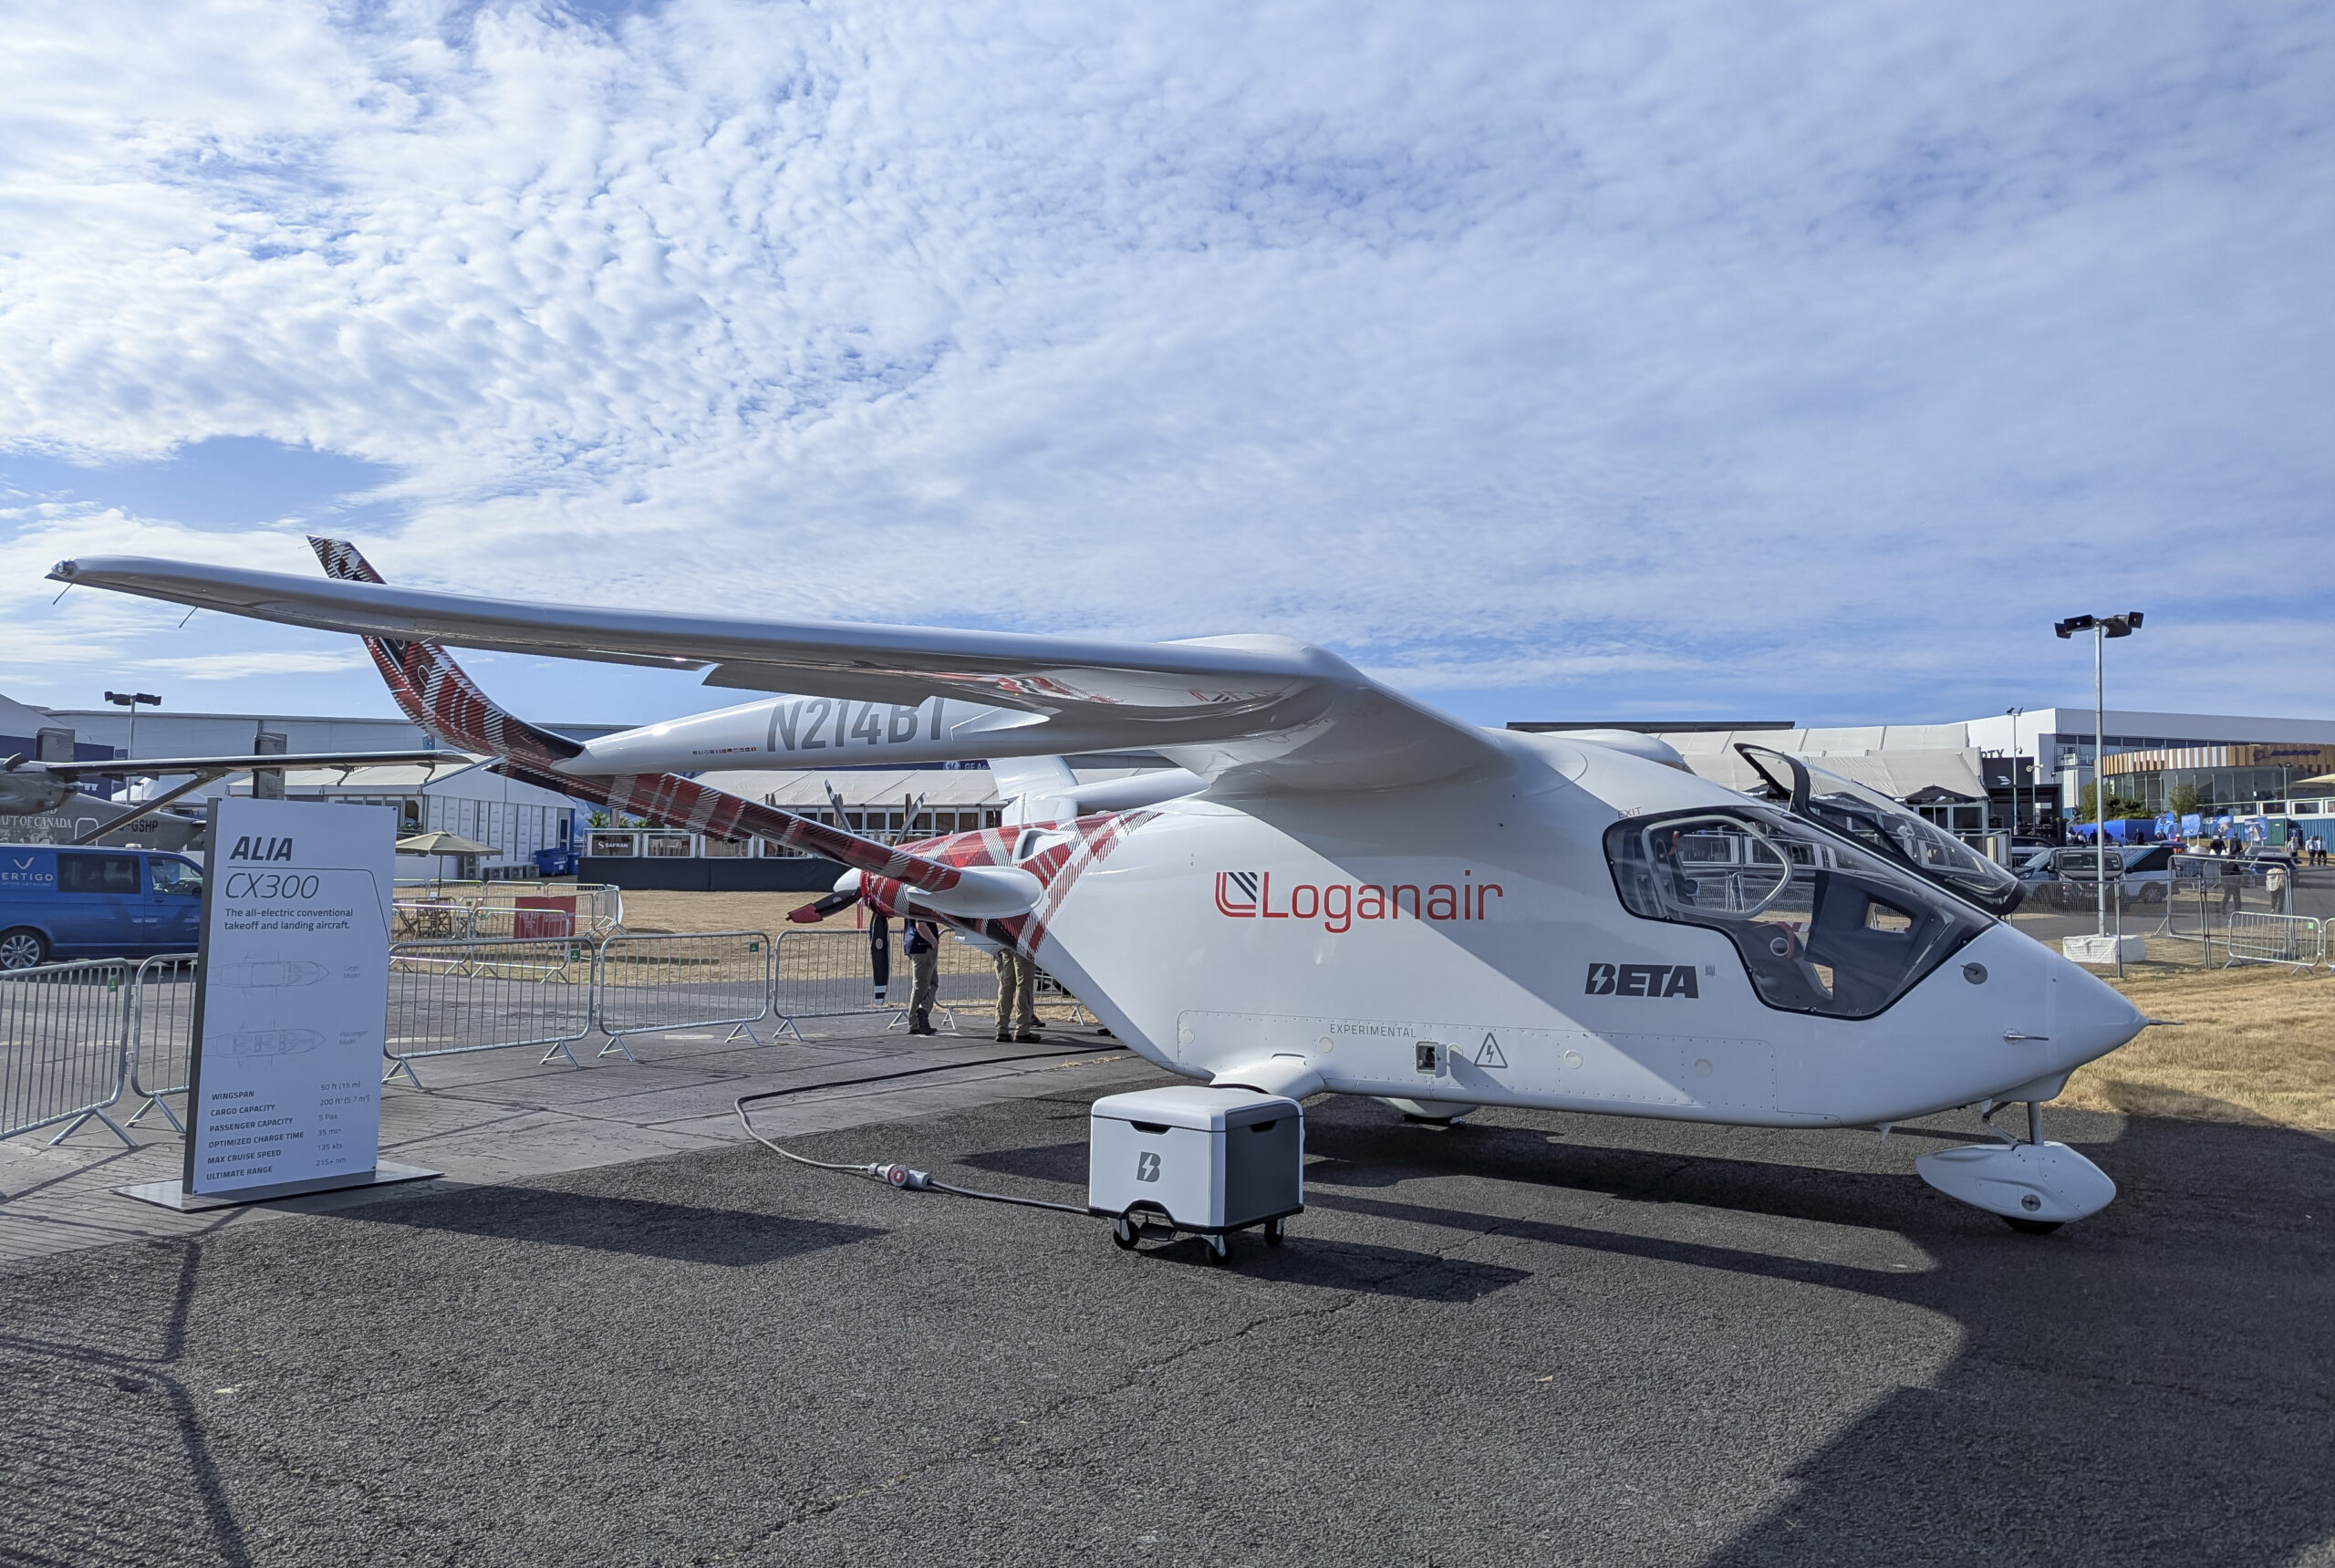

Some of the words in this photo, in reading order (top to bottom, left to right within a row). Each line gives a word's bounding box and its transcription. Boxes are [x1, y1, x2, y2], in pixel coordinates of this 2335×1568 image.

[1617, 806, 1641, 818] EXIT
[35, 816, 72, 828] CANADA
[229, 836, 293, 861] ALIA
[1, 872, 53, 881] ERTIGO
[225, 872, 319, 899] CX300
[1262, 869, 1504, 934] Loganair
[225, 908, 244, 917] The
[245, 908, 295, 917] all-electric
[296, 908, 353, 917] conventional
[224, 920, 259, 930] takeoff
[261, 920, 278, 929] and
[281, 920, 314, 931] landing
[316, 919, 351, 929] aircraft.
[1584, 962, 1699, 999] BETA
[1330, 1023, 1417, 1038] EXPERIMENTAL
[351, 1080, 360, 1088] m)
[212, 1090, 254, 1101] WINGSPAN
[319, 1098, 334, 1106] 200
[211, 1106, 237, 1116] CARGO
[239, 1104, 275, 1114] CAPACITY
[209, 1121, 255, 1132] PASSENGER
[257, 1117, 294, 1127] CAPACITY
[208, 1137, 252, 1148] OPTIMIZED
[253, 1133, 285, 1144] CHARGE
[285, 1131, 305, 1139] TIME
[317, 1143, 330, 1151] 135
[207, 1156, 226, 1164] MAX
[227, 1152, 255, 1162] CRUISE
[256, 1149, 282, 1158] SPEED
[206, 1168, 245, 1180] ULTIMATE
[246, 1166, 273, 1175] RANGE
